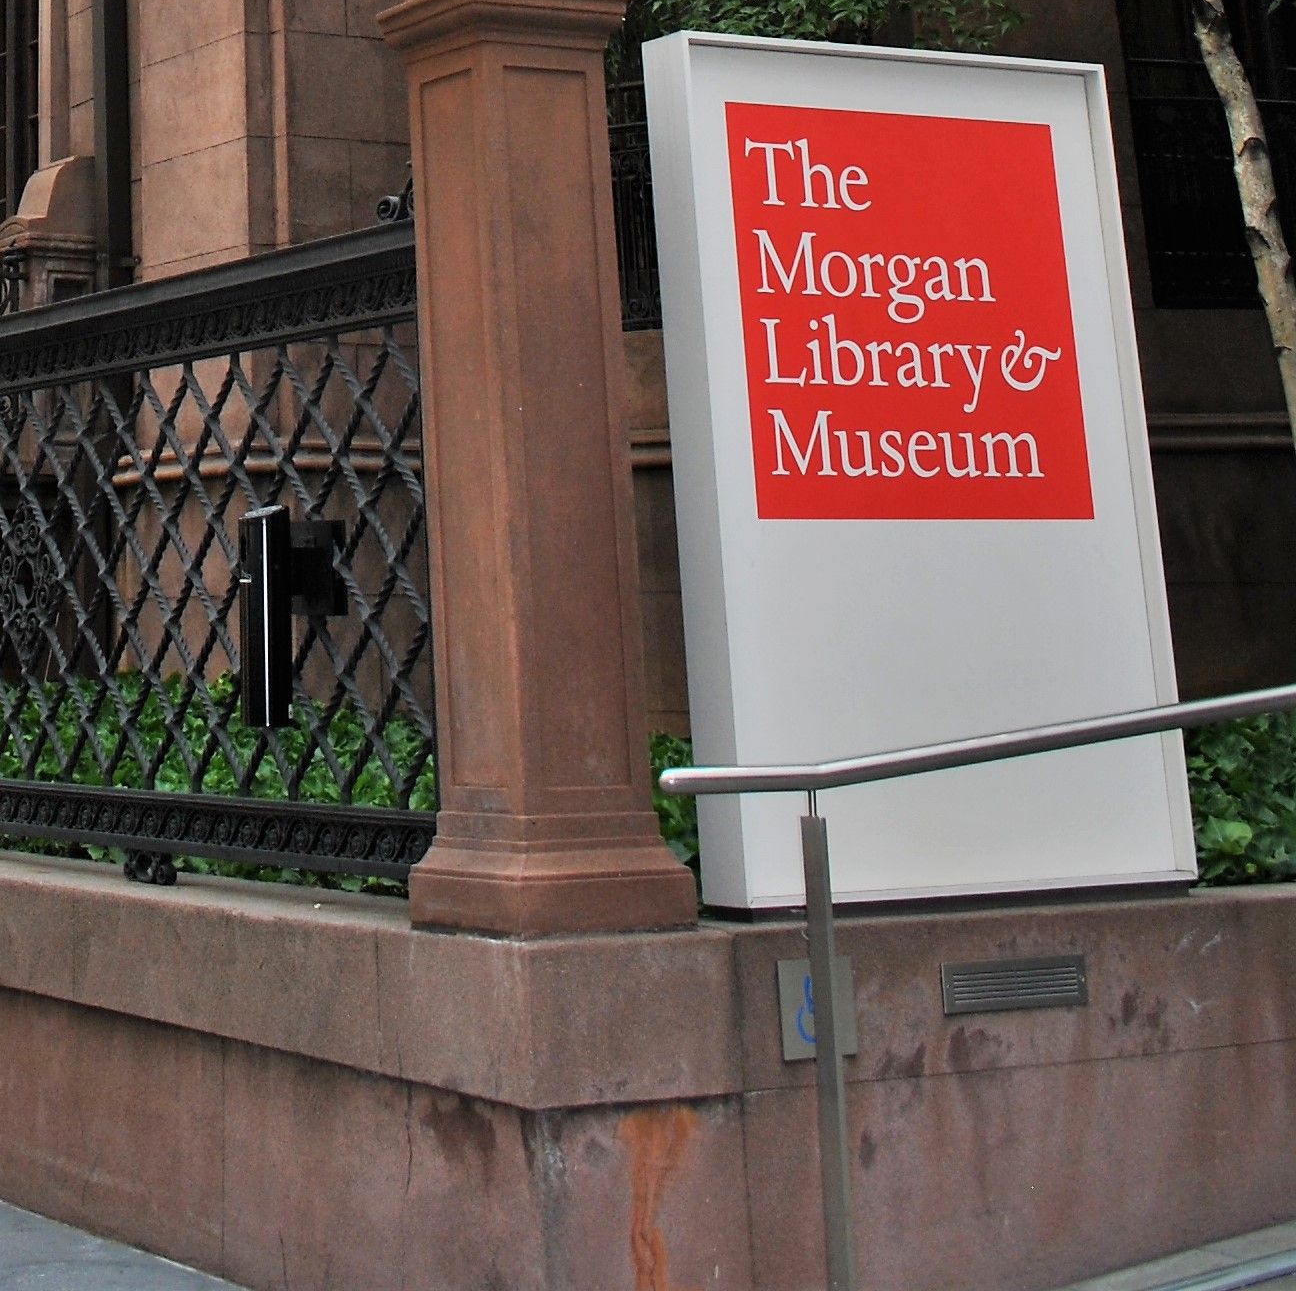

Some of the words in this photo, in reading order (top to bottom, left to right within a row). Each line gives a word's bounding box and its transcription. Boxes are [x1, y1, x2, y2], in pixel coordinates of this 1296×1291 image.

[745, 138, 871, 210] The
[753, 229, 996, 323] Morgan
[760, 314, 991, 412] Library
[1001, 330, 1061, 391] &
[768, 410, 1044, 477] Museum
